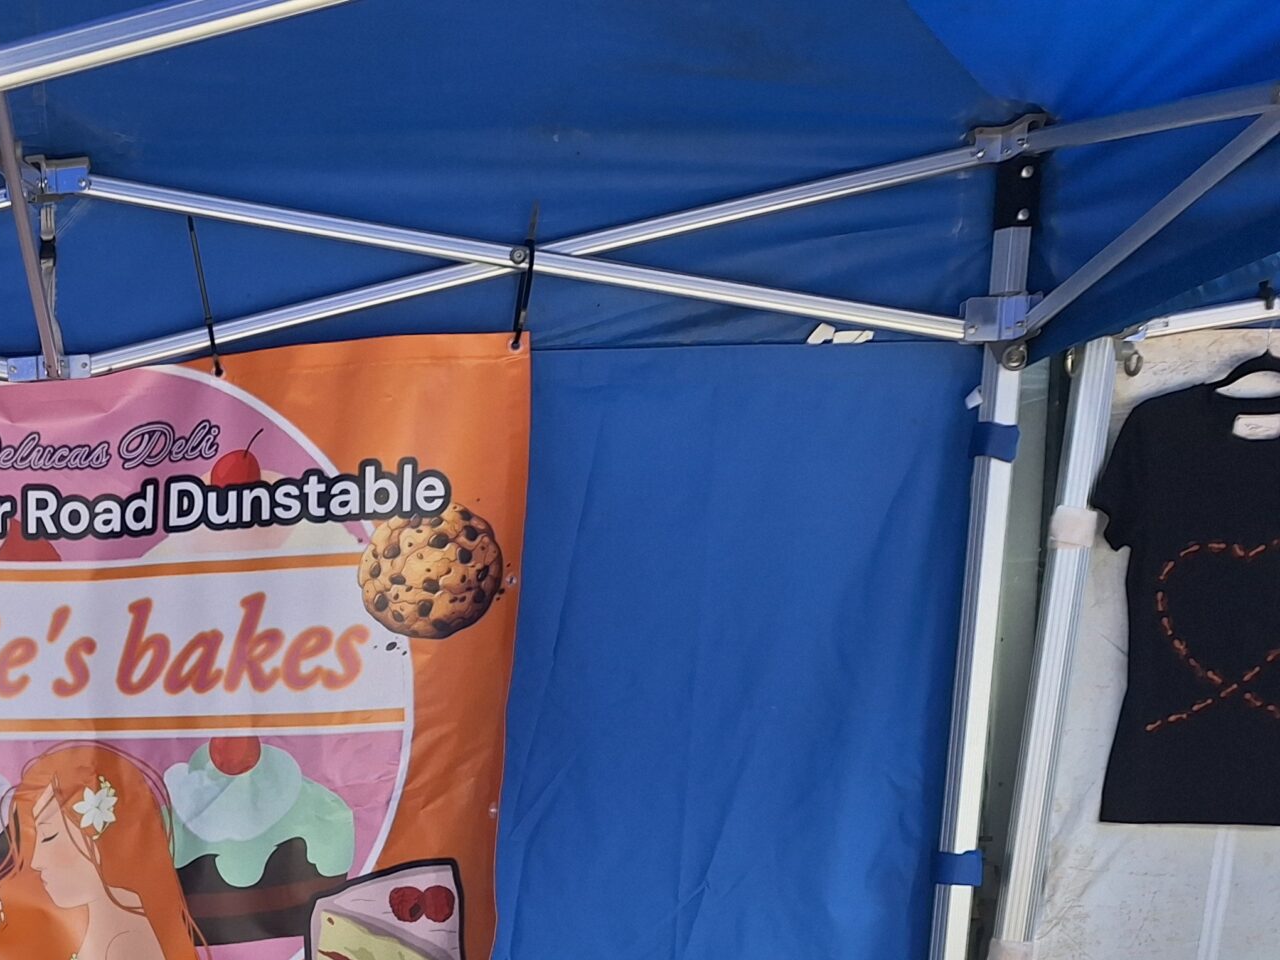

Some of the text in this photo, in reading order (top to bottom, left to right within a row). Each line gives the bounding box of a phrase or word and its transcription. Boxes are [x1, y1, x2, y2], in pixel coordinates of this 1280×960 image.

[119, 420, 221, 469] Deli
[26, 484, 155, 534] Road
[168, 463, 446, 527] Dunstable
[116, 591, 370, 696] bakes
